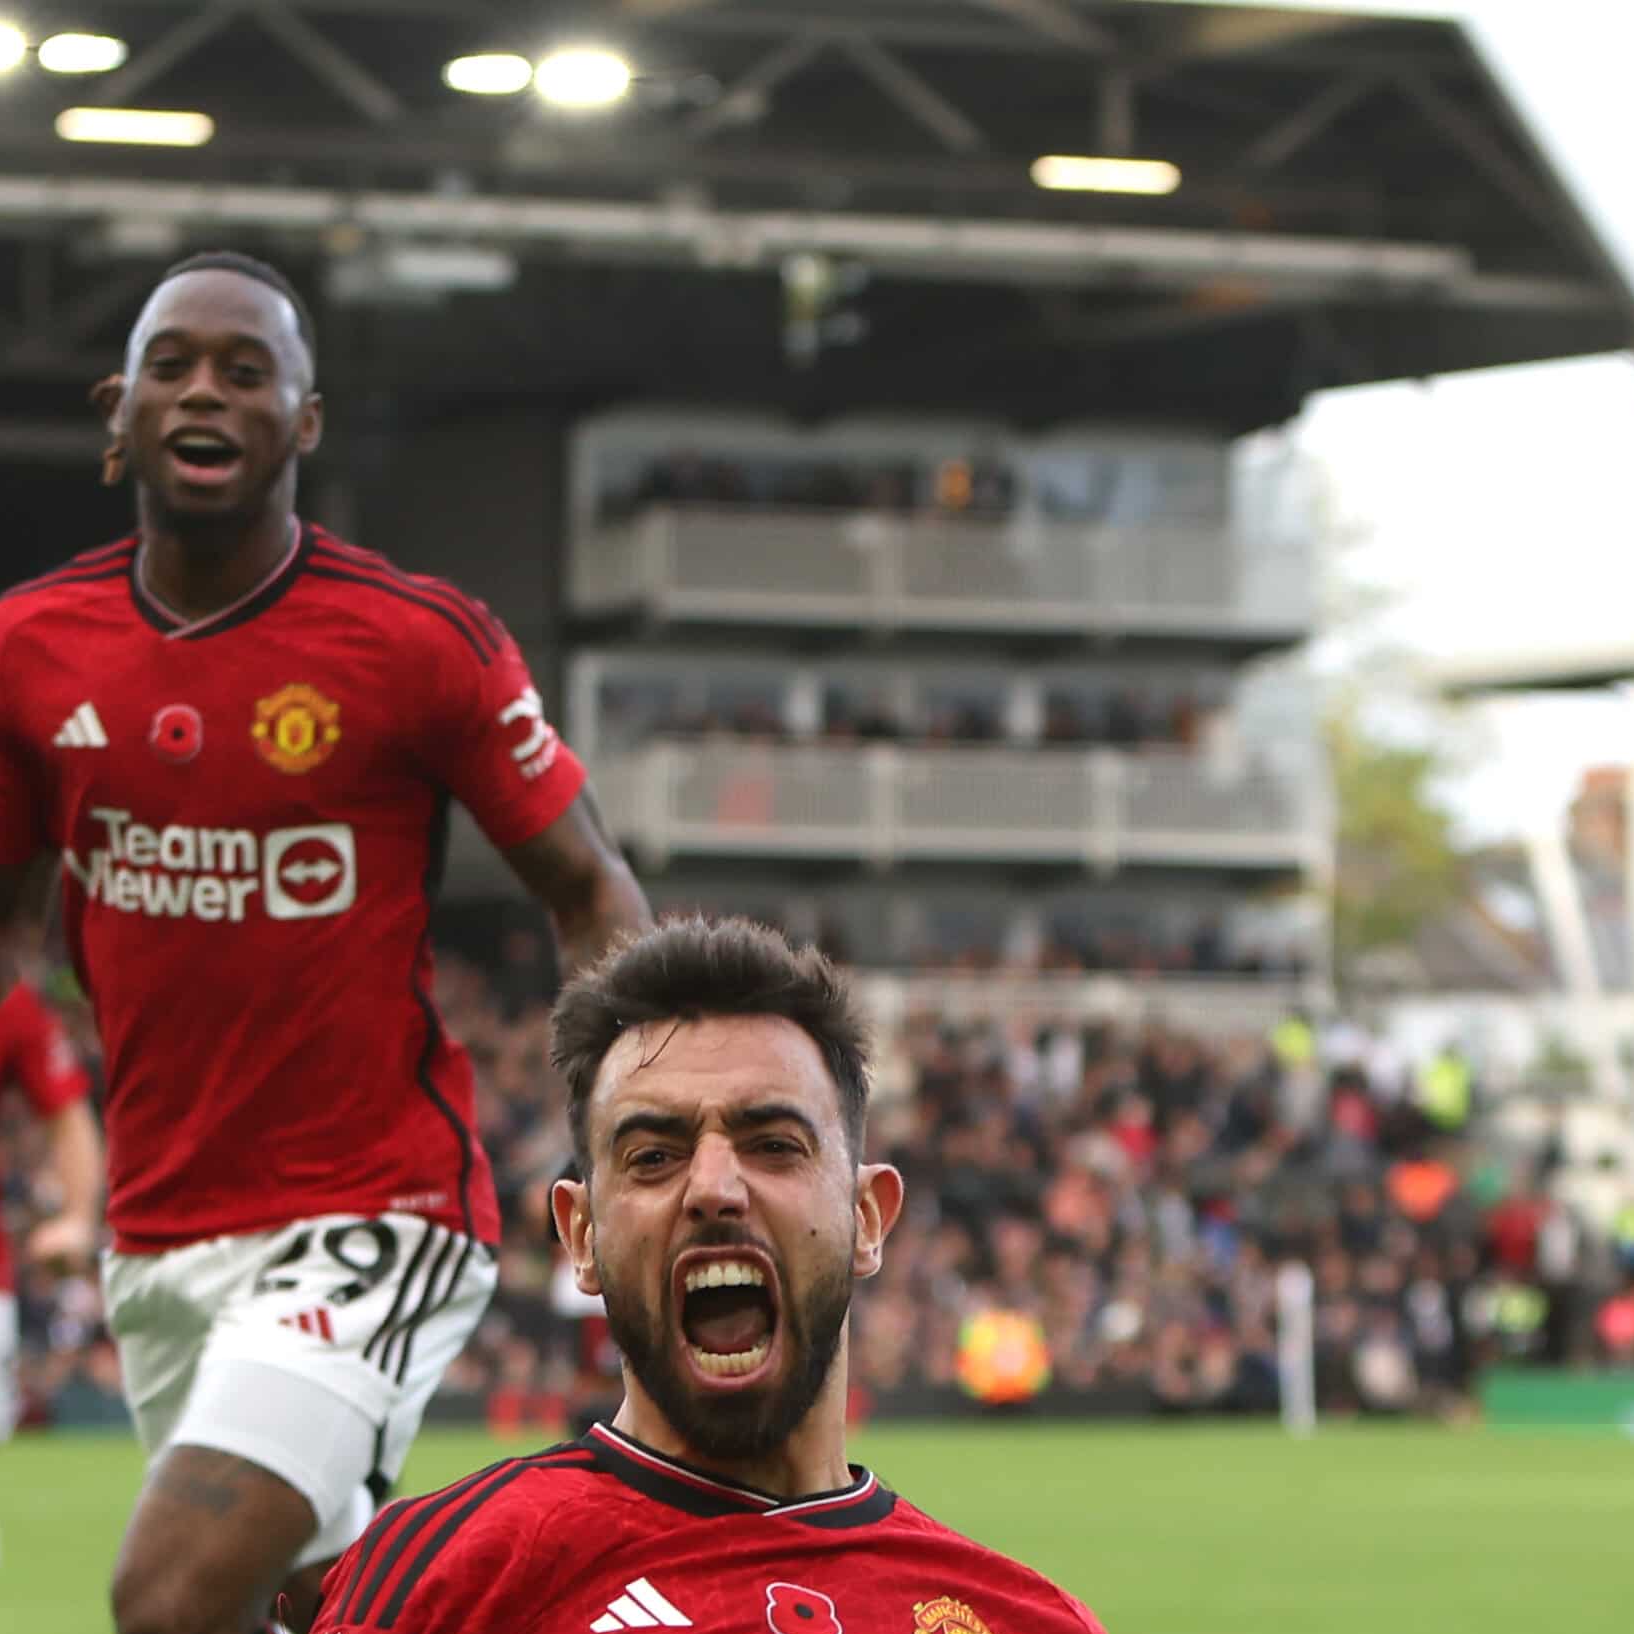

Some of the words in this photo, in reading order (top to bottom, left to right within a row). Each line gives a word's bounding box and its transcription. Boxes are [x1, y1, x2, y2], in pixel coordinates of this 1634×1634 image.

[89, 808, 259, 873] Team
[64, 848, 259, 923] Viewer
[253, 1221, 399, 1306] 29
